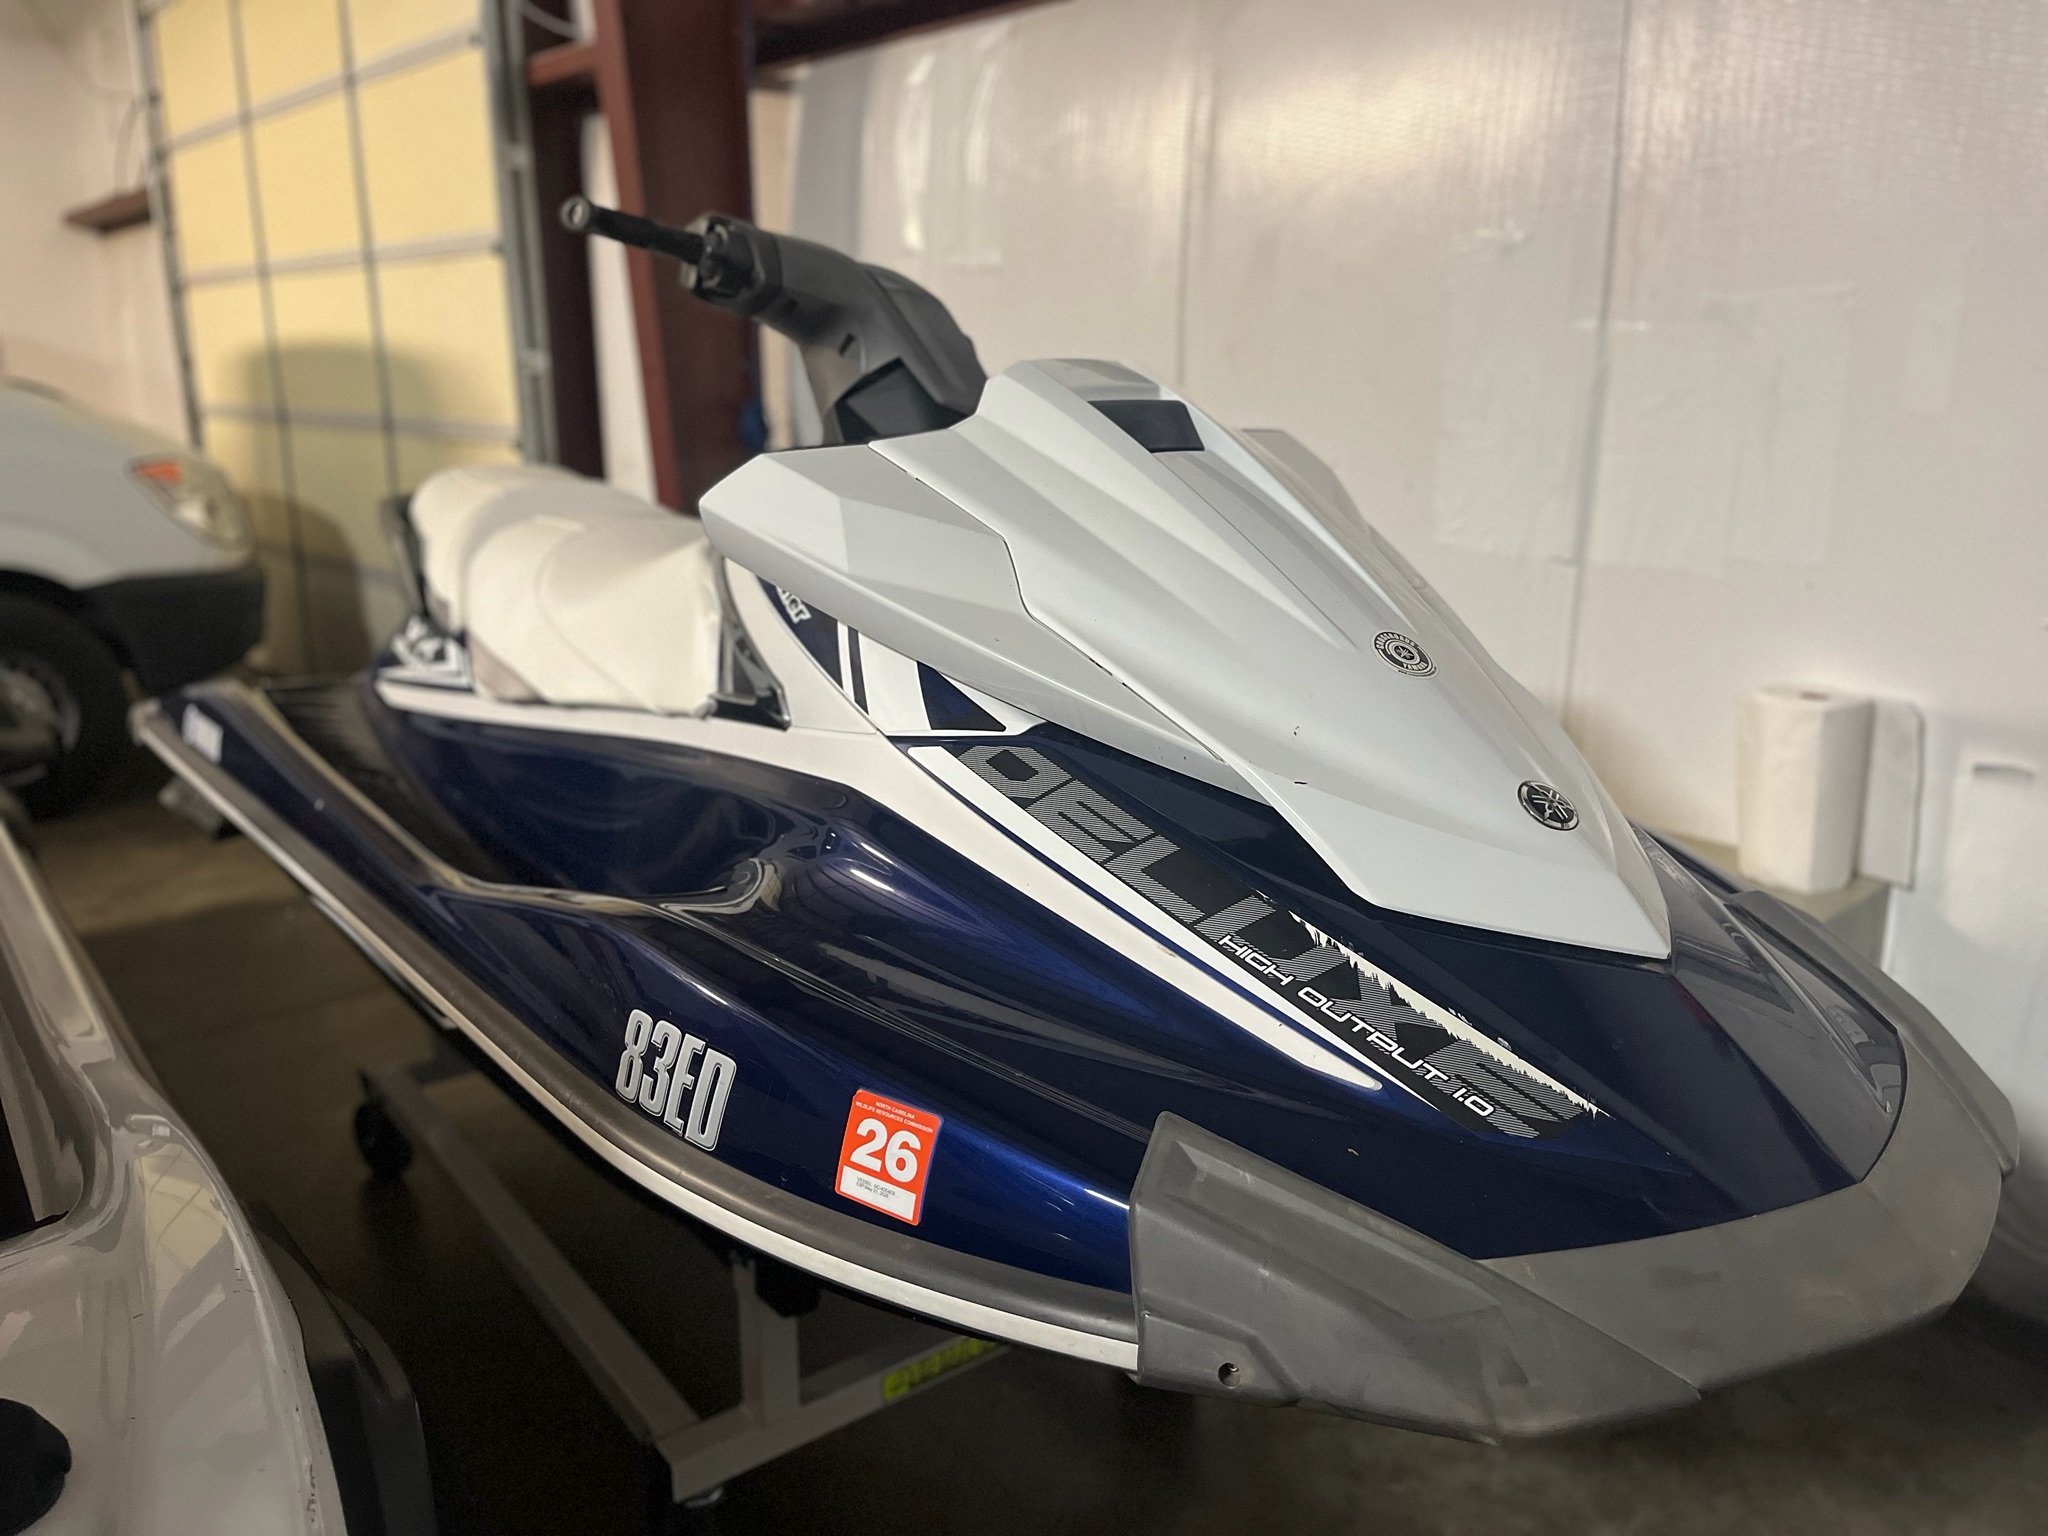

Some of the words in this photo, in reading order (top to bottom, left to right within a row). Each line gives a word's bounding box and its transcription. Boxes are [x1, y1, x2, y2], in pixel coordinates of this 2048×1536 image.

[958, 745, 1580, 1139] DELUXE
[1218, 934, 1294, 986] HIGH
[1297, 986, 1450, 1083] OUTPUT
[1452, 1087, 1494, 1117] 1.0
[615, 1008, 737, 1152] 83ED
[855, 1101, 875, 1112] WILDLIFE
[875, 1108, 903, 1123] RESOURCES
[903, 1118, 934, 1134] COMMISSION
[875, 1101, 891, 1112] NORTH
[891, 1107, 915, 1119] CAROLINA
[850, 1117, 921, 1183] 26
